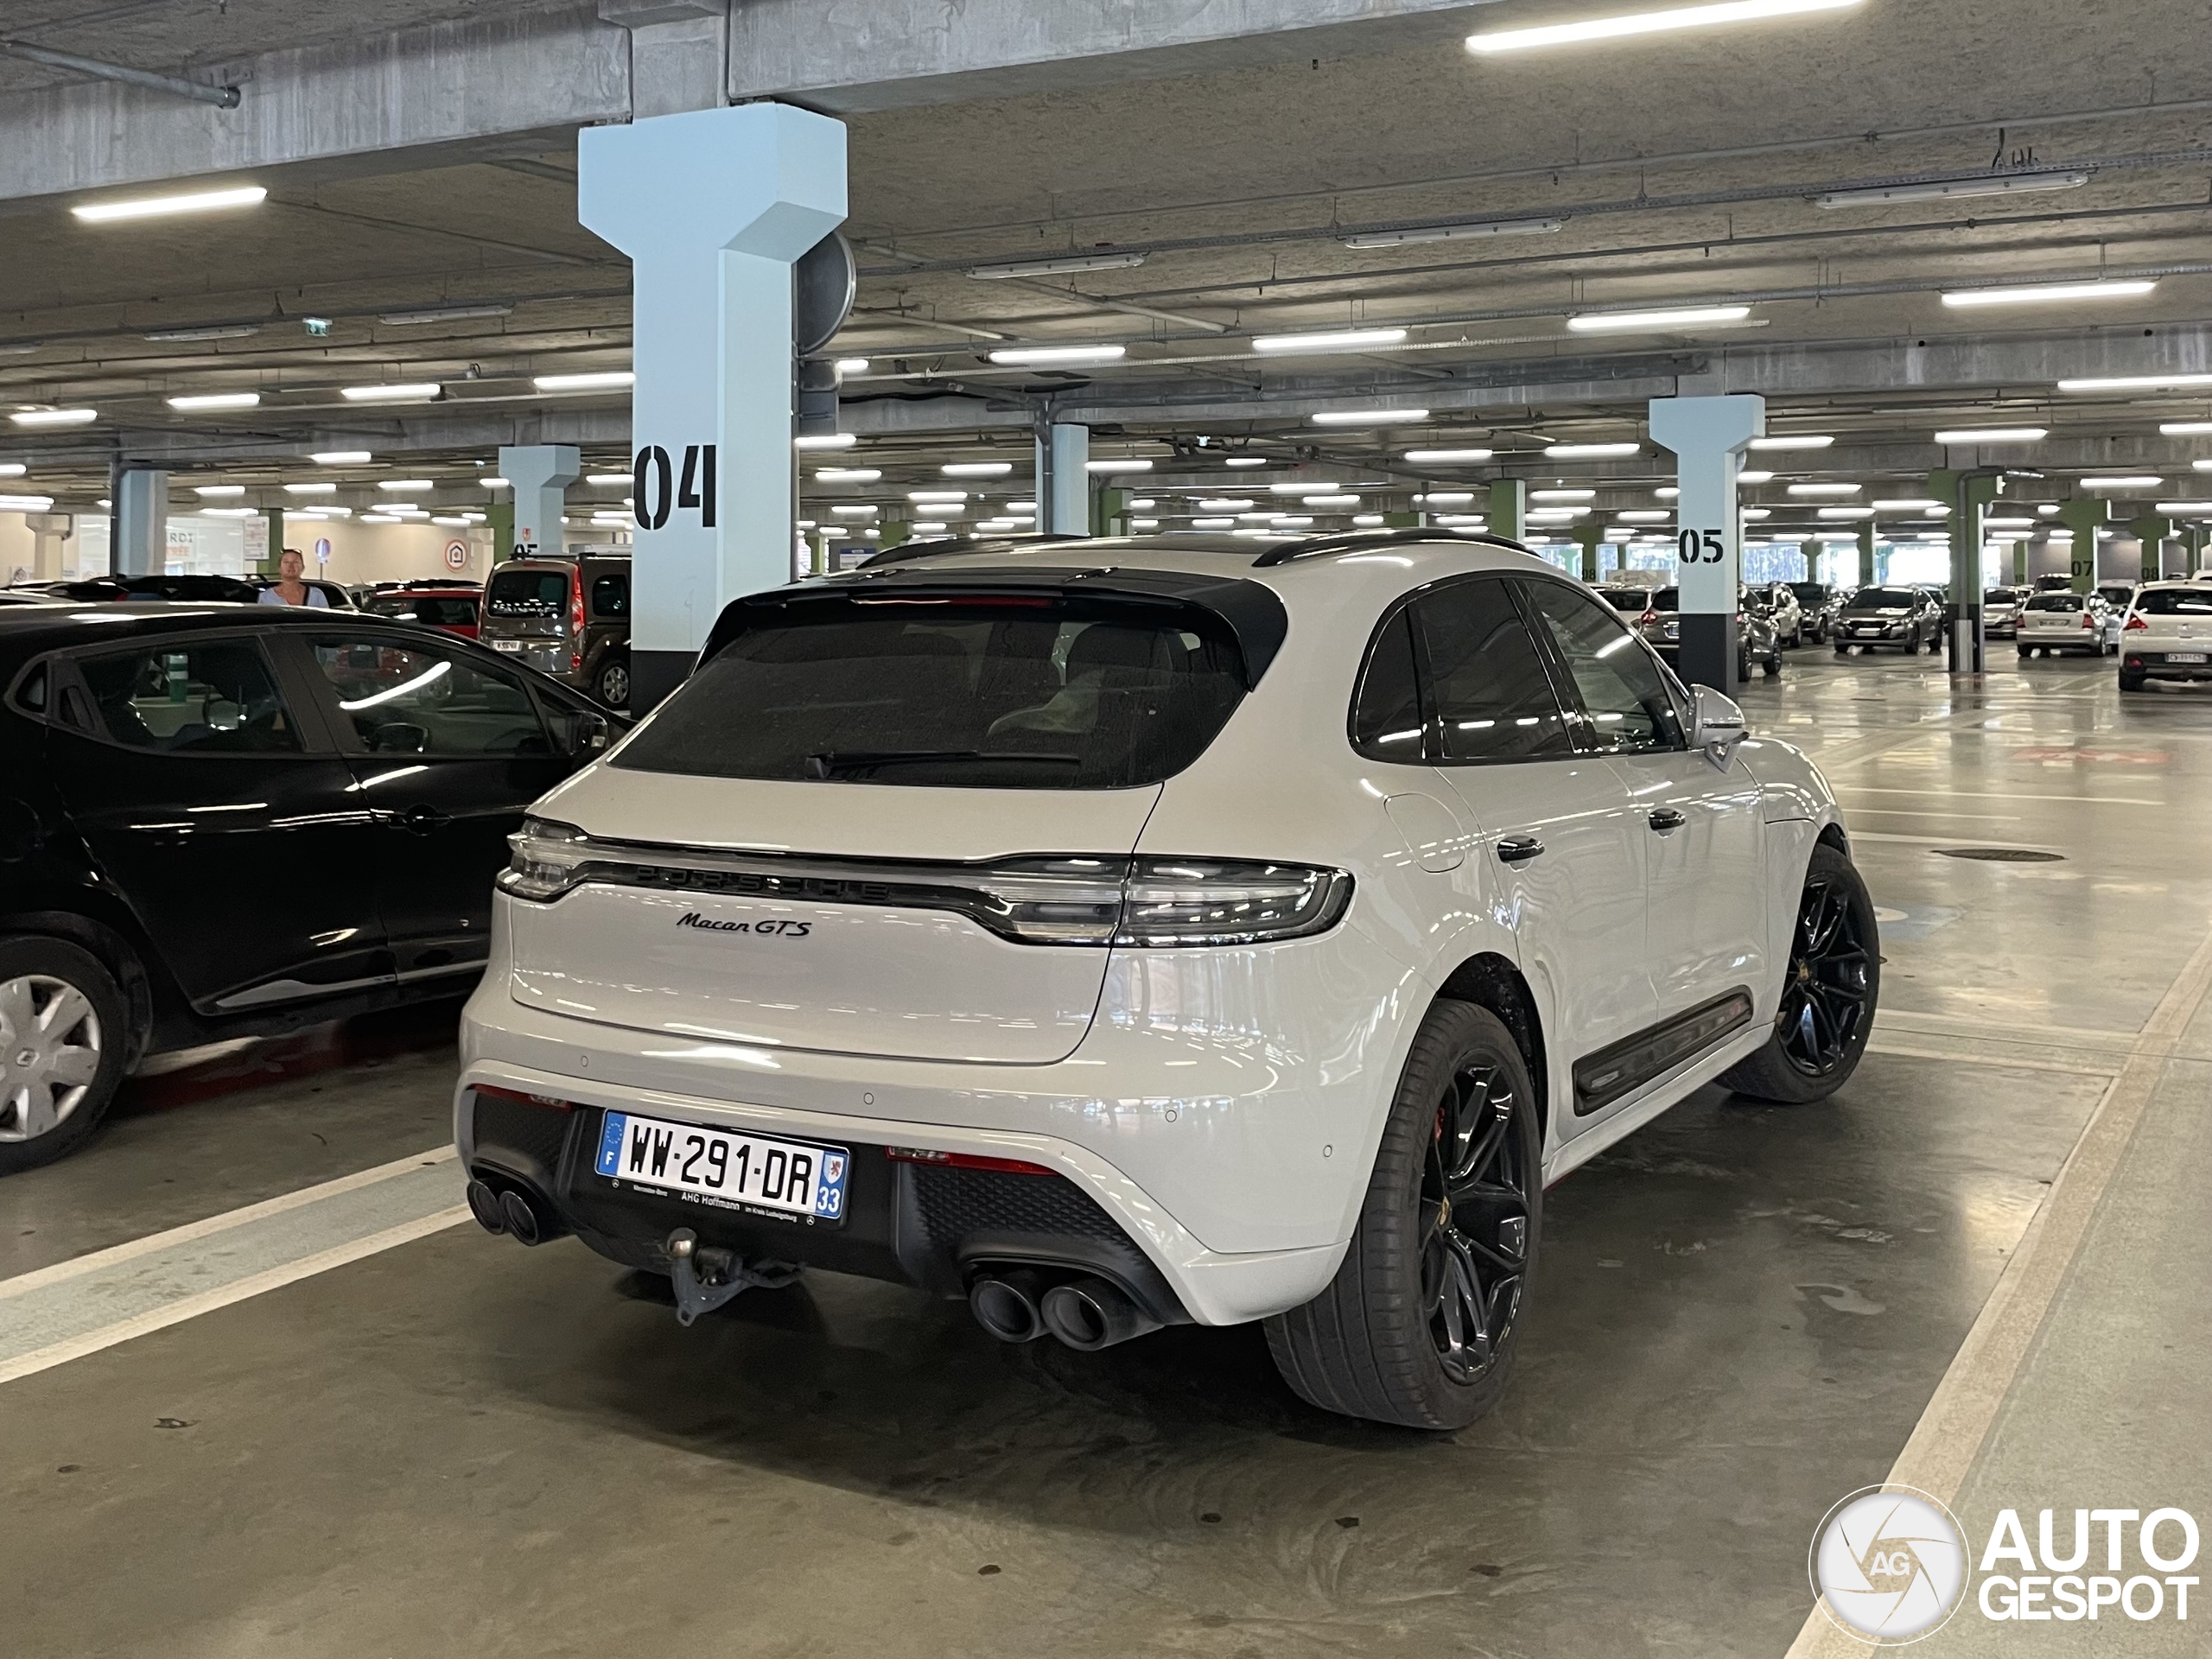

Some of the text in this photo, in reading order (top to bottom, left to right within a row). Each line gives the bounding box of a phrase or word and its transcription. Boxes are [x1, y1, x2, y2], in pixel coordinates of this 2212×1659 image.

[633, 445, 716, 530] 04
[166, 532, 194, 543] RDI
[1679, 529, 1724, 563] 05
[2071, 560, 2094, 576] 07
[2141, 567, 2159, 580] 08
[677, 912, 812, 936] Macan GTS
[605, 1151, 615, 1166] F
[629, 1124, 813, 1205] WW-291-DR
[681, 1192, 700, 1205] AHG
[702, 1194, 741, 1211] Hoffmann
[817, 1186, 841, 1213] 33
